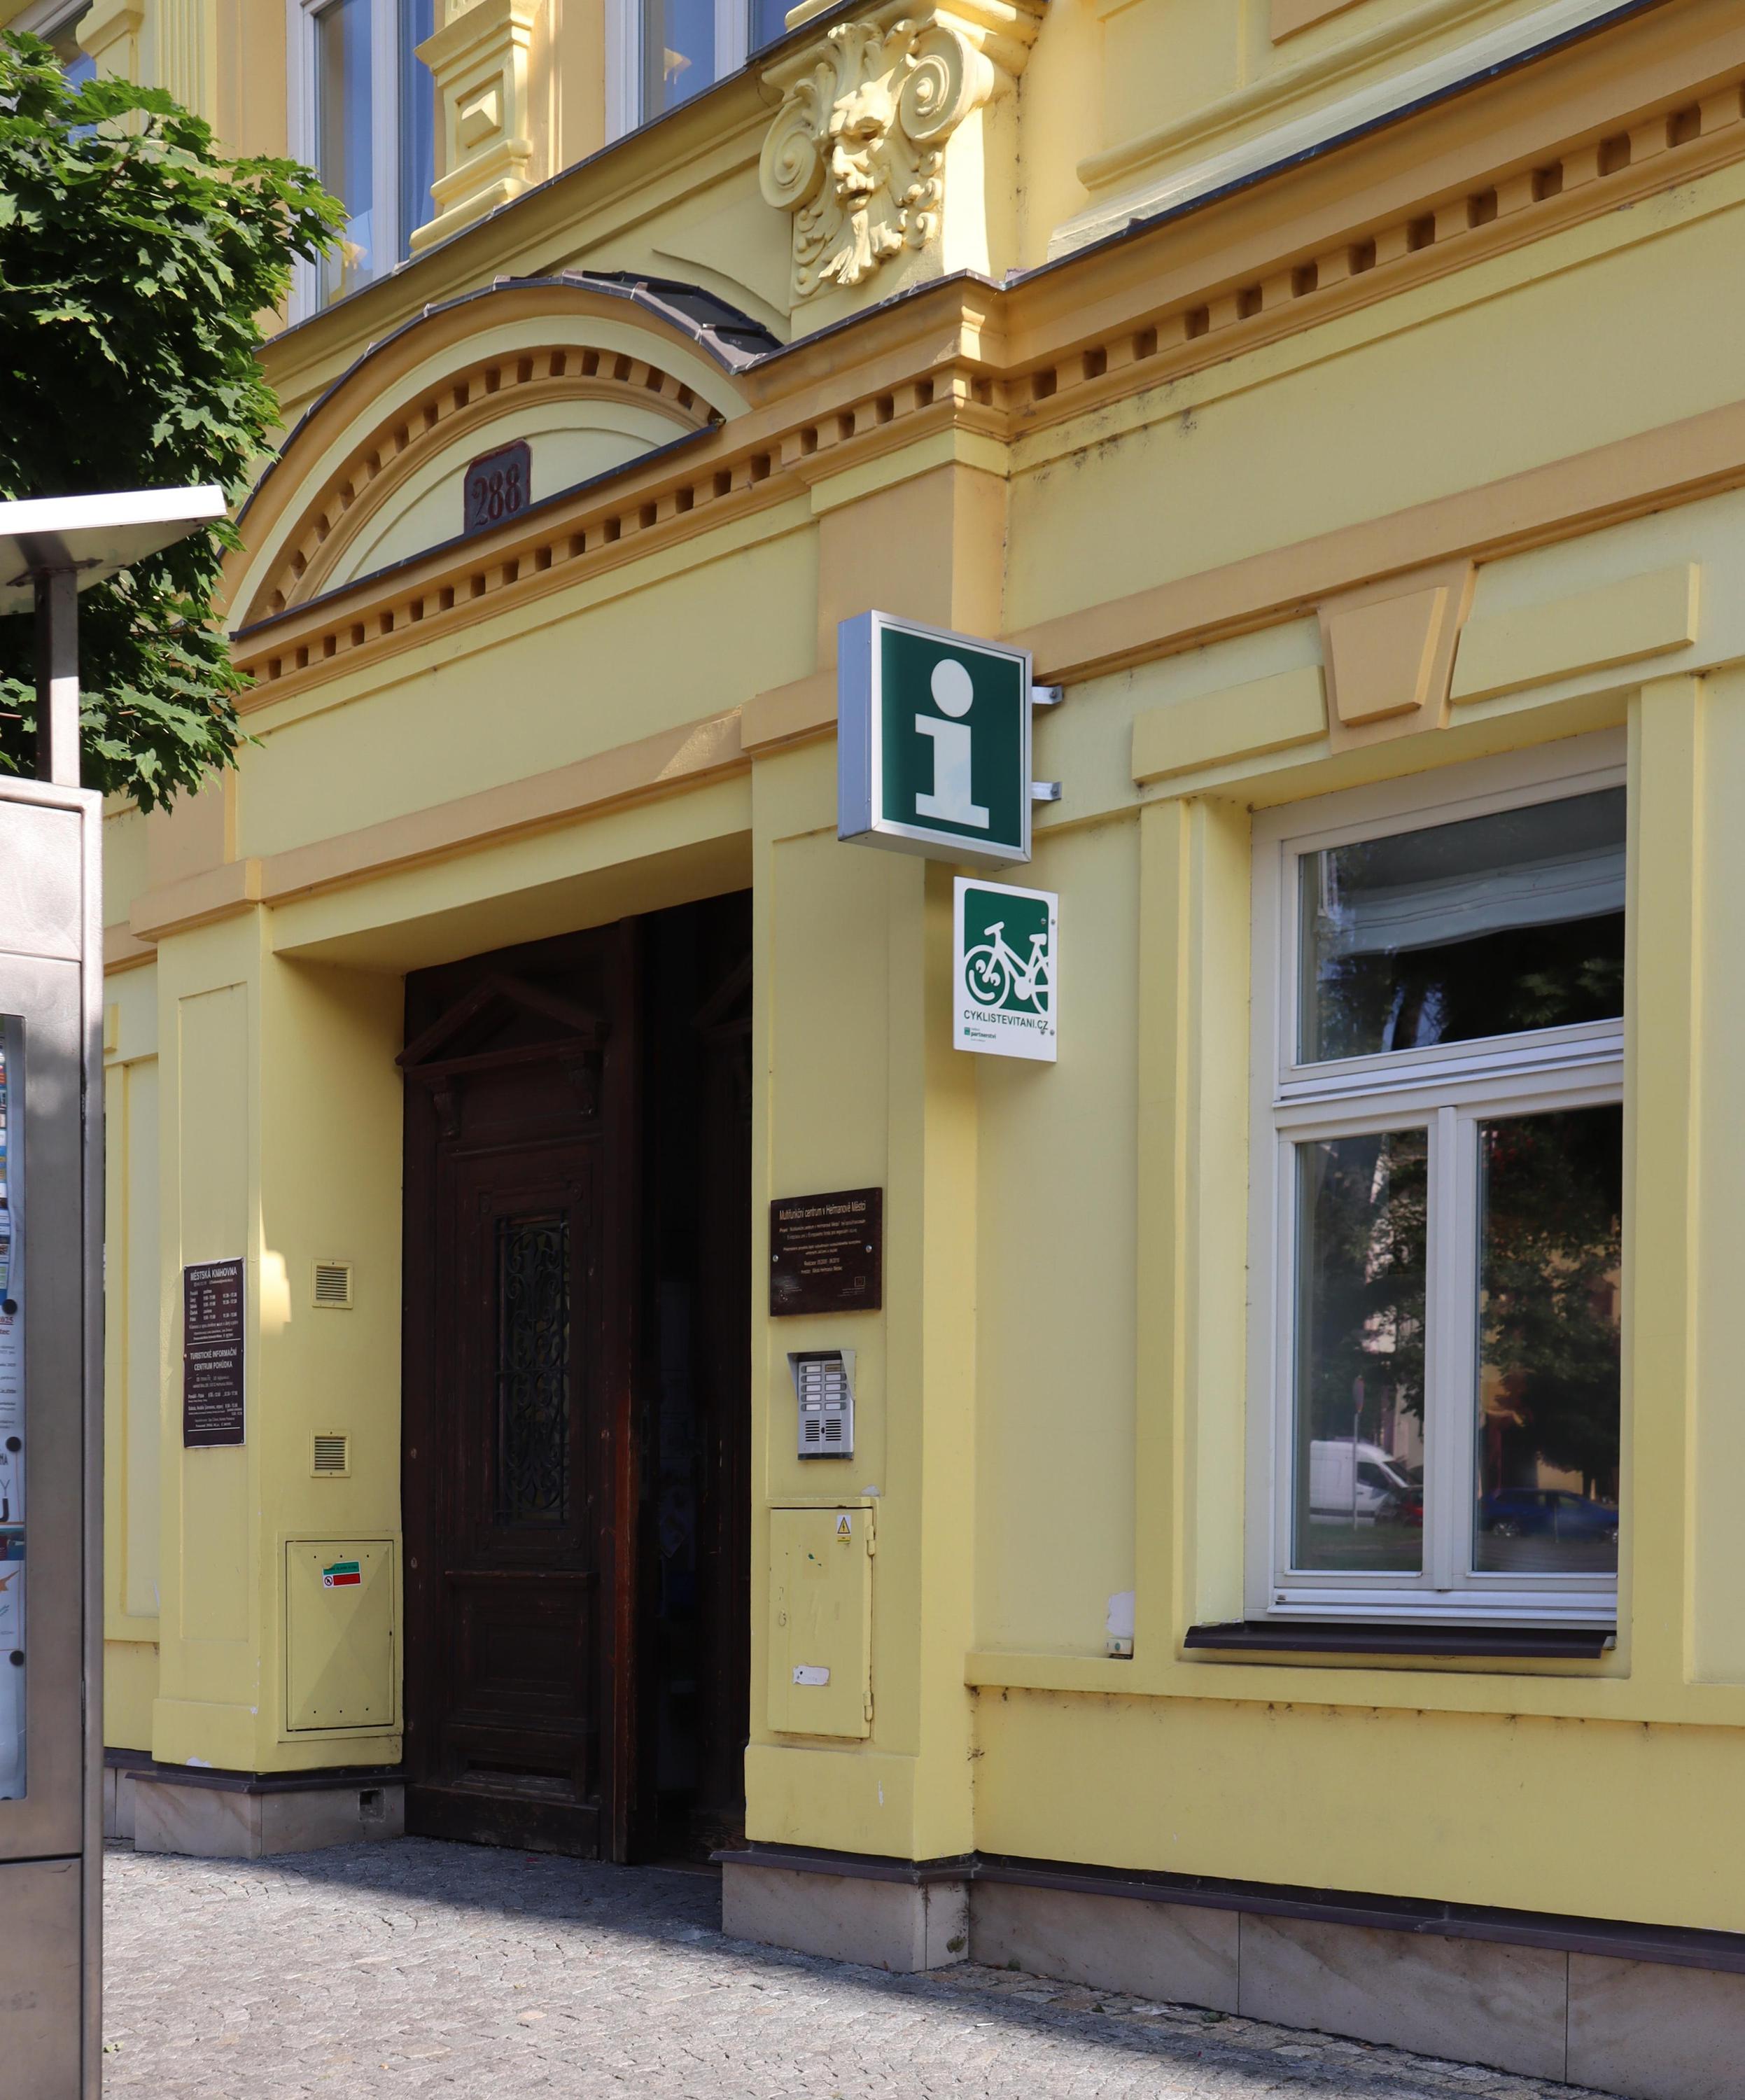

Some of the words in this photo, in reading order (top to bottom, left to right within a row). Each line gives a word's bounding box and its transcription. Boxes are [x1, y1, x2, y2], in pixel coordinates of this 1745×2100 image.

[471, 463, 522, 528] 288
[963, 1009, 1049, 1030] CYKLISTEVITANI.CZ
[804, 1206, 822, 1218] centrum
[822, 1208, 826, 1216] v
[190, 1268, 211, 1281] MĚSTSKÁ
[211, 1266, 237, 1278] KNIHOVNA
[190, 1350, 212, 1360] TURISTICKÉ
[212, 1346, 237, 1358] INFORMAČNÍ
[194, 1362, 213, 1371] CENTRUM
